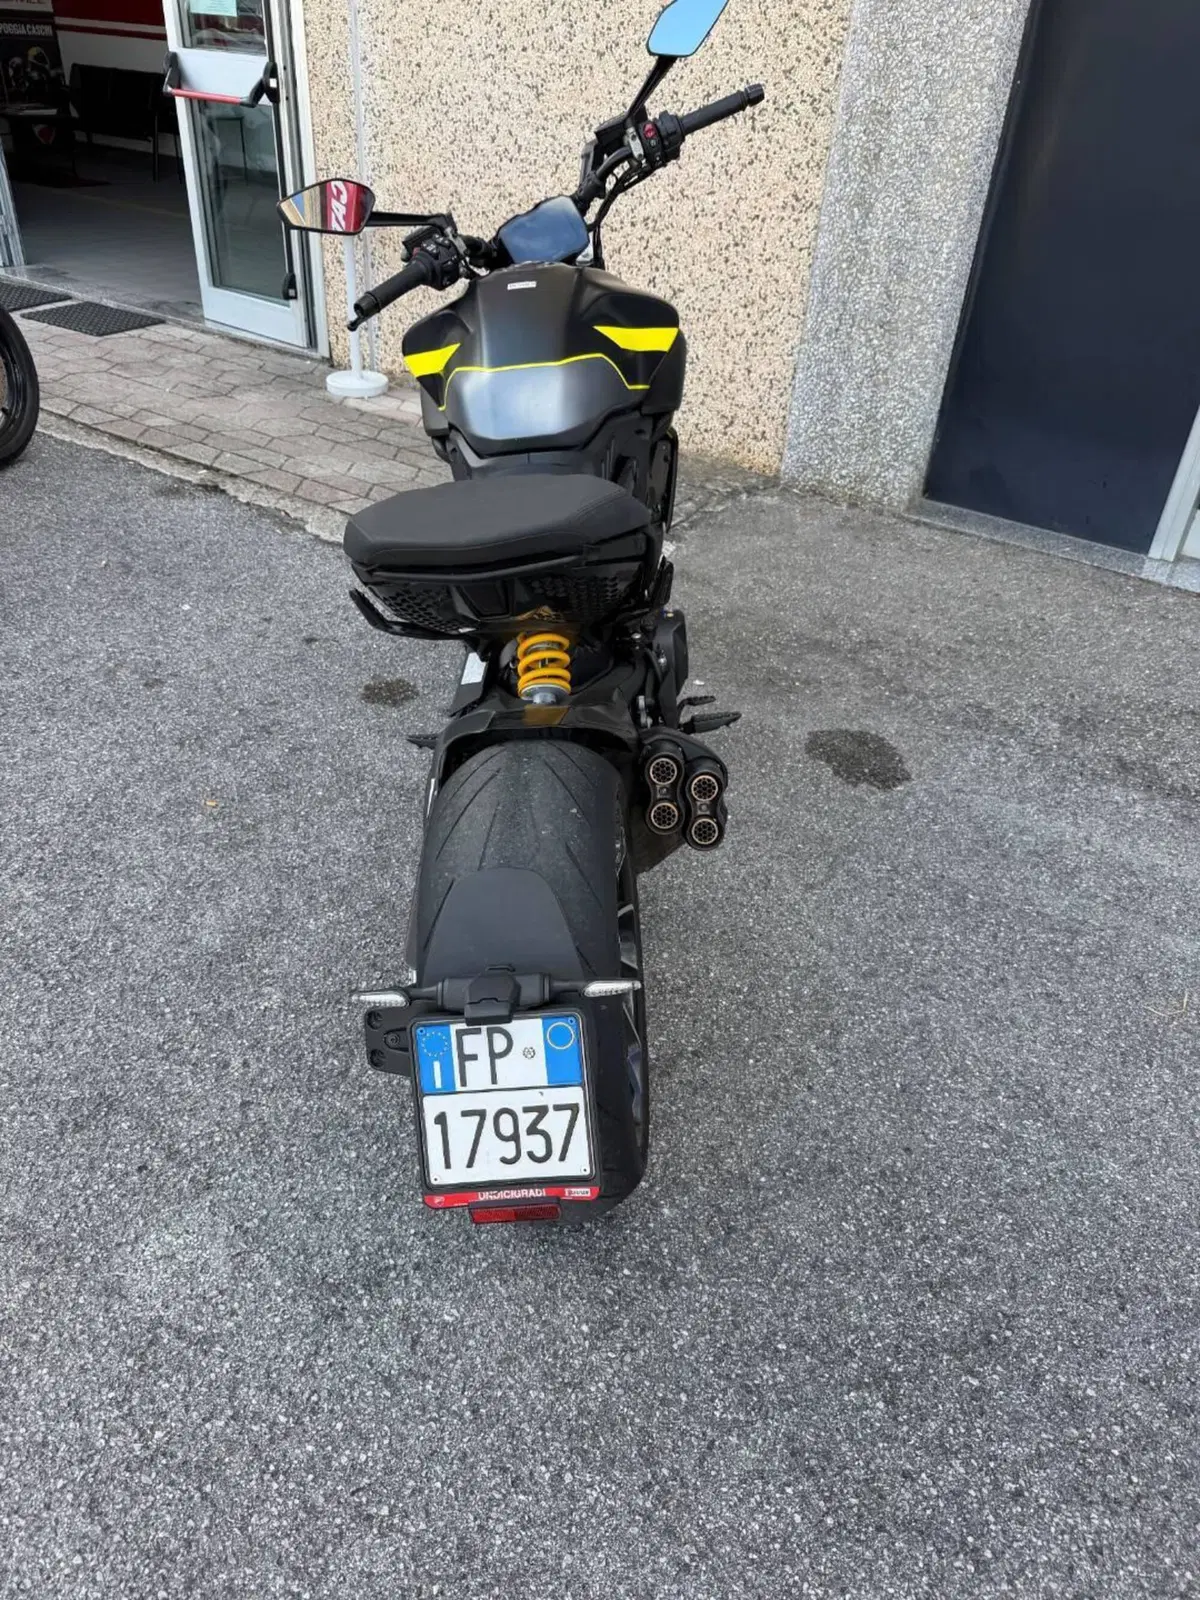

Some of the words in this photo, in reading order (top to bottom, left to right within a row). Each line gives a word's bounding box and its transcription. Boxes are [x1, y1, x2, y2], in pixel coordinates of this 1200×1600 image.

[455, 1026, 514, 1087] FP
[433, 1102, 580, 1170] 17937
[478, 1188, 546, 1200] UNDICIGRADI
